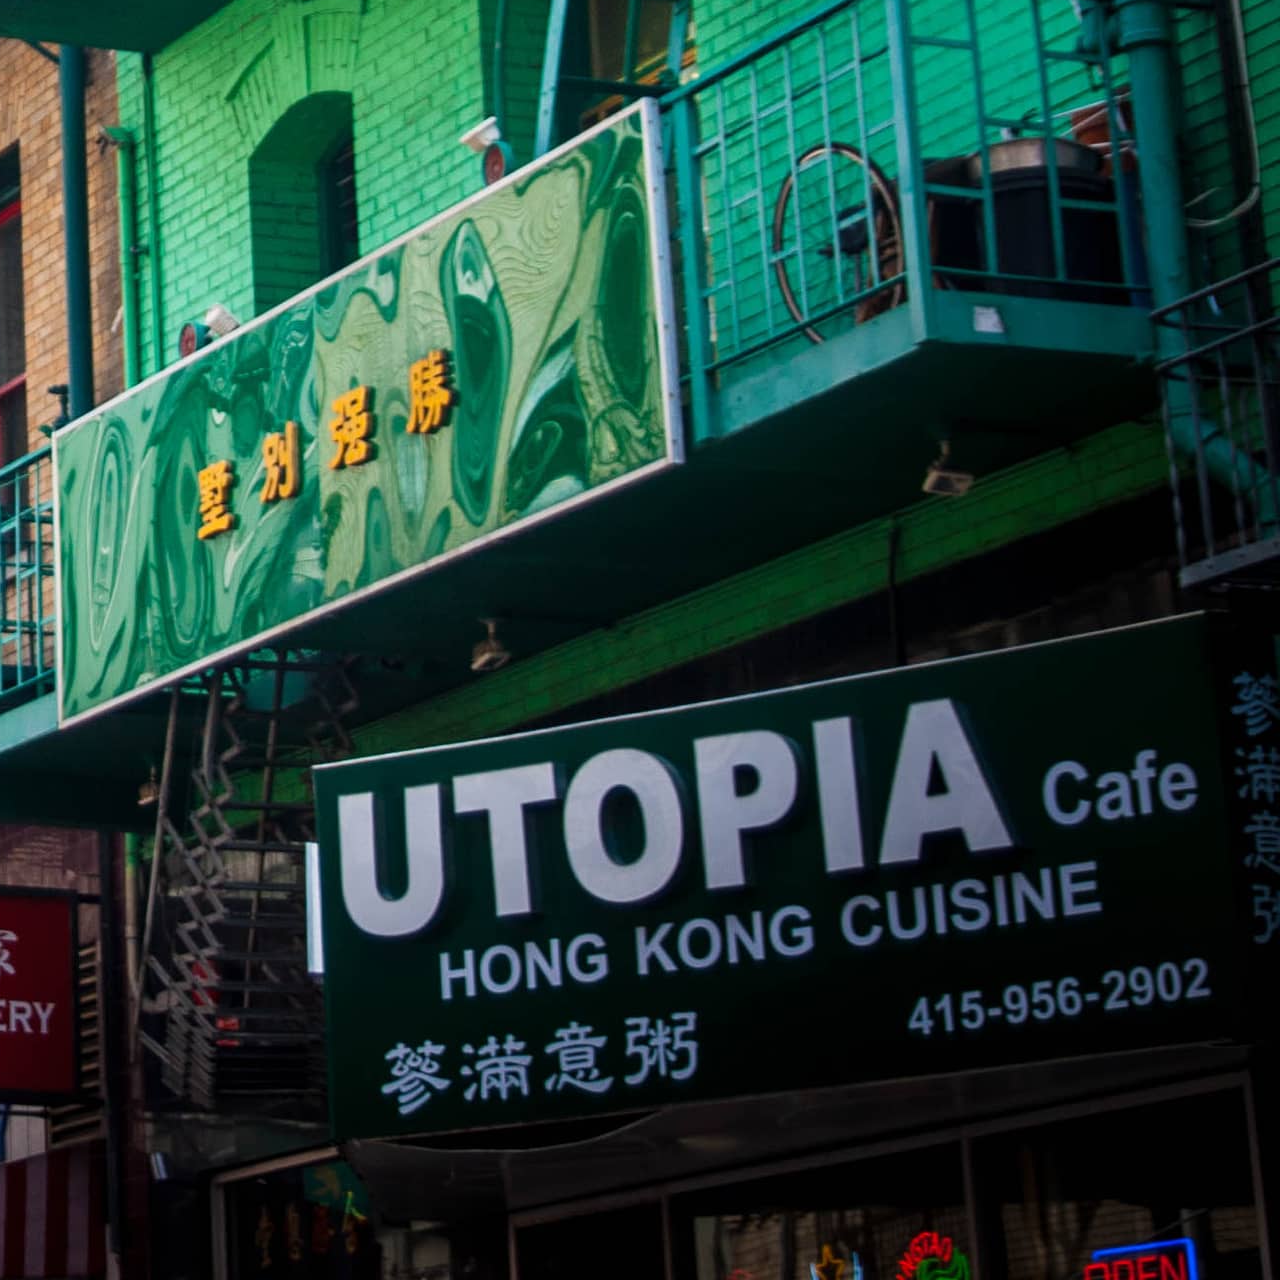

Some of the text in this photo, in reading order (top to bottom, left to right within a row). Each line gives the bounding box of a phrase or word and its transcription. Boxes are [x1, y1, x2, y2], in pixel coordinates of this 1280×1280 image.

[337, 699, 1197, 936] UTOPIA Cafe
[440, 861, 1102, 1000] HONG KONG CUISINE
[909, 958, 1211, 1036] 415-956-2902
